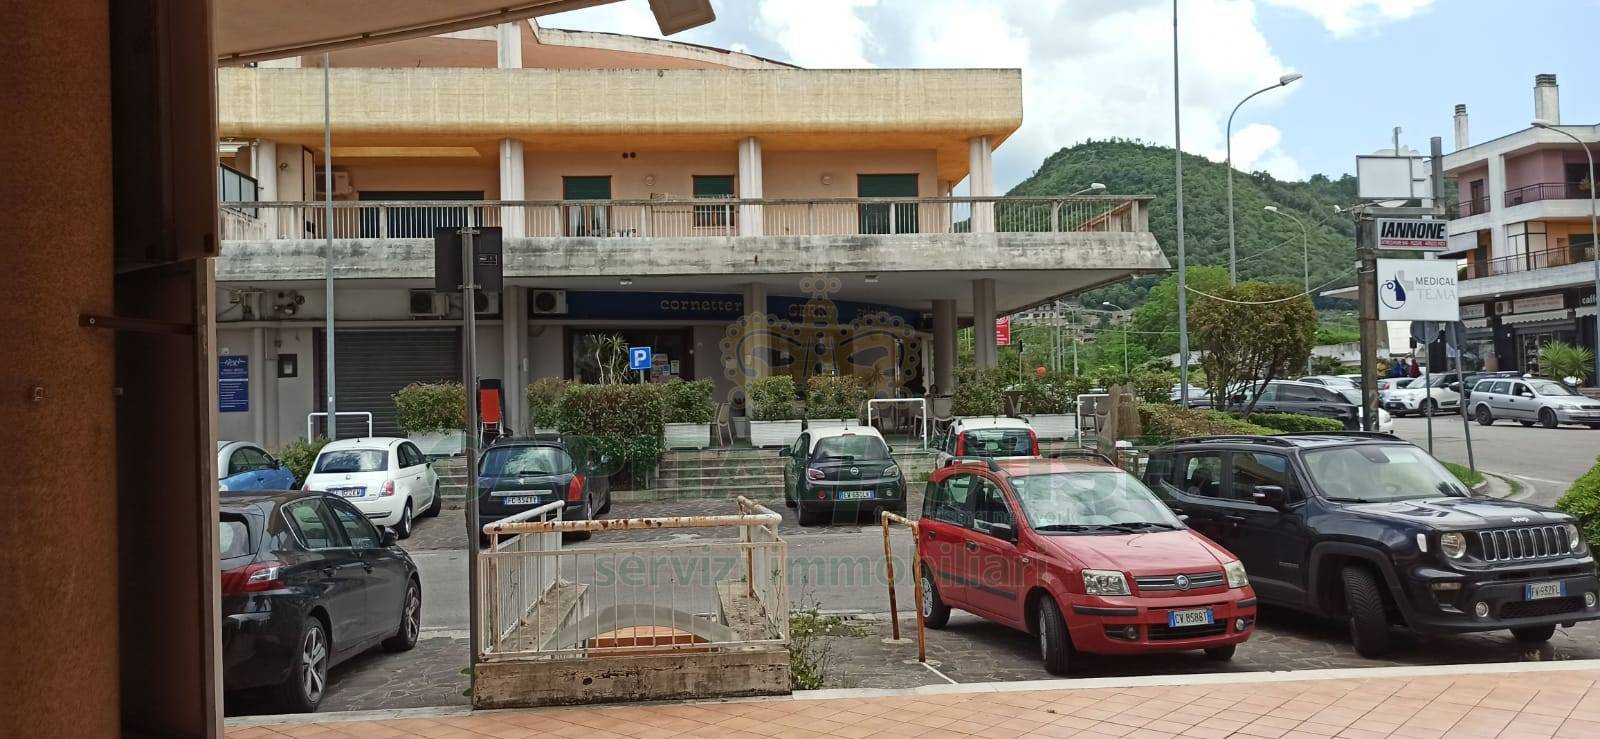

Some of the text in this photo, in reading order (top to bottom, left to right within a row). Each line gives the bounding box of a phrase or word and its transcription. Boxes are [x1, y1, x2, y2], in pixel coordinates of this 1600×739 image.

[1381, 222, 1446, 239] IANNONE
[1415, 277, 1456, 286] MEDICAL
[1416, 289, 1457, 301] TEMA
[634, 349, 647, 367] P
